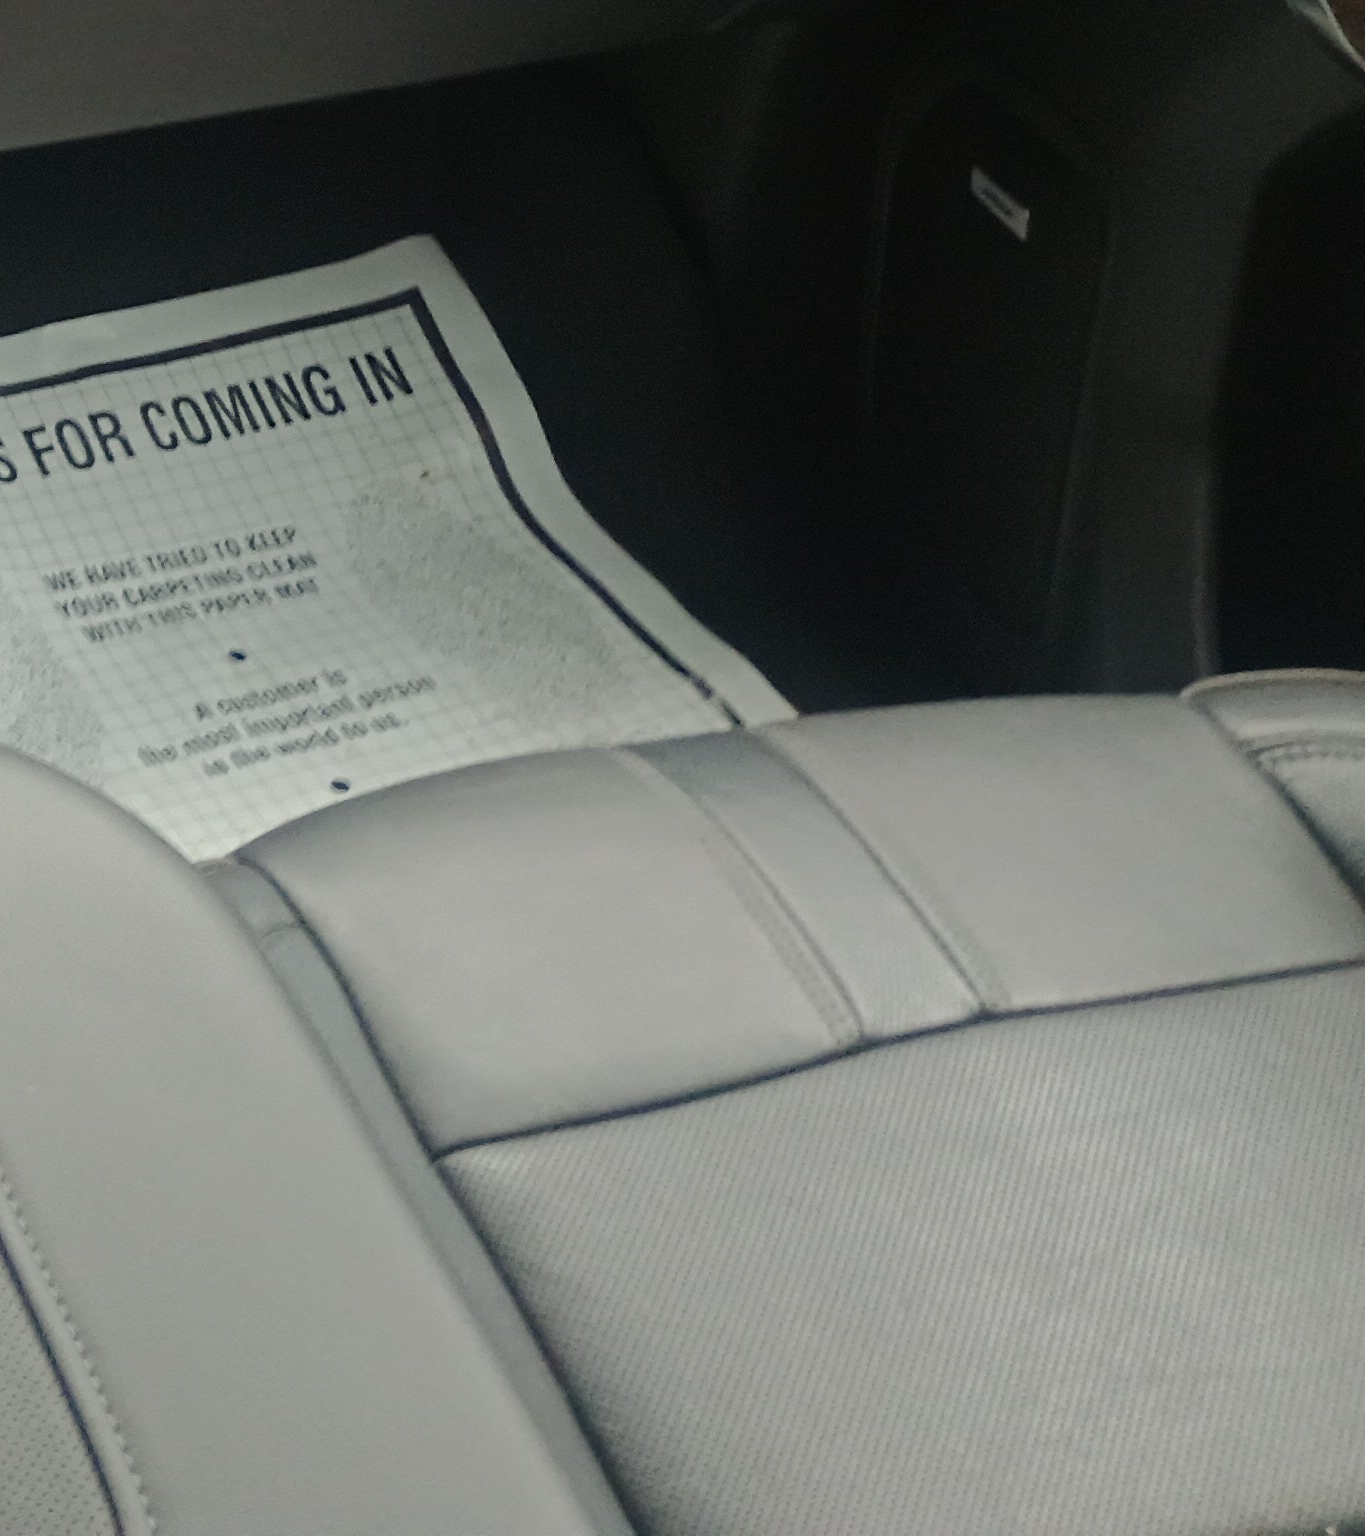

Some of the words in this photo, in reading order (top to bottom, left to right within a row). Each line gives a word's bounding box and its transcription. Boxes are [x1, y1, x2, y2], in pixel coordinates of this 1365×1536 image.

[23, 411, 135, 476] FOR
[140, 364, 347, 452] COMING
[349, 346, 415, 406] IN
[213, 536, 241, 560] TO
